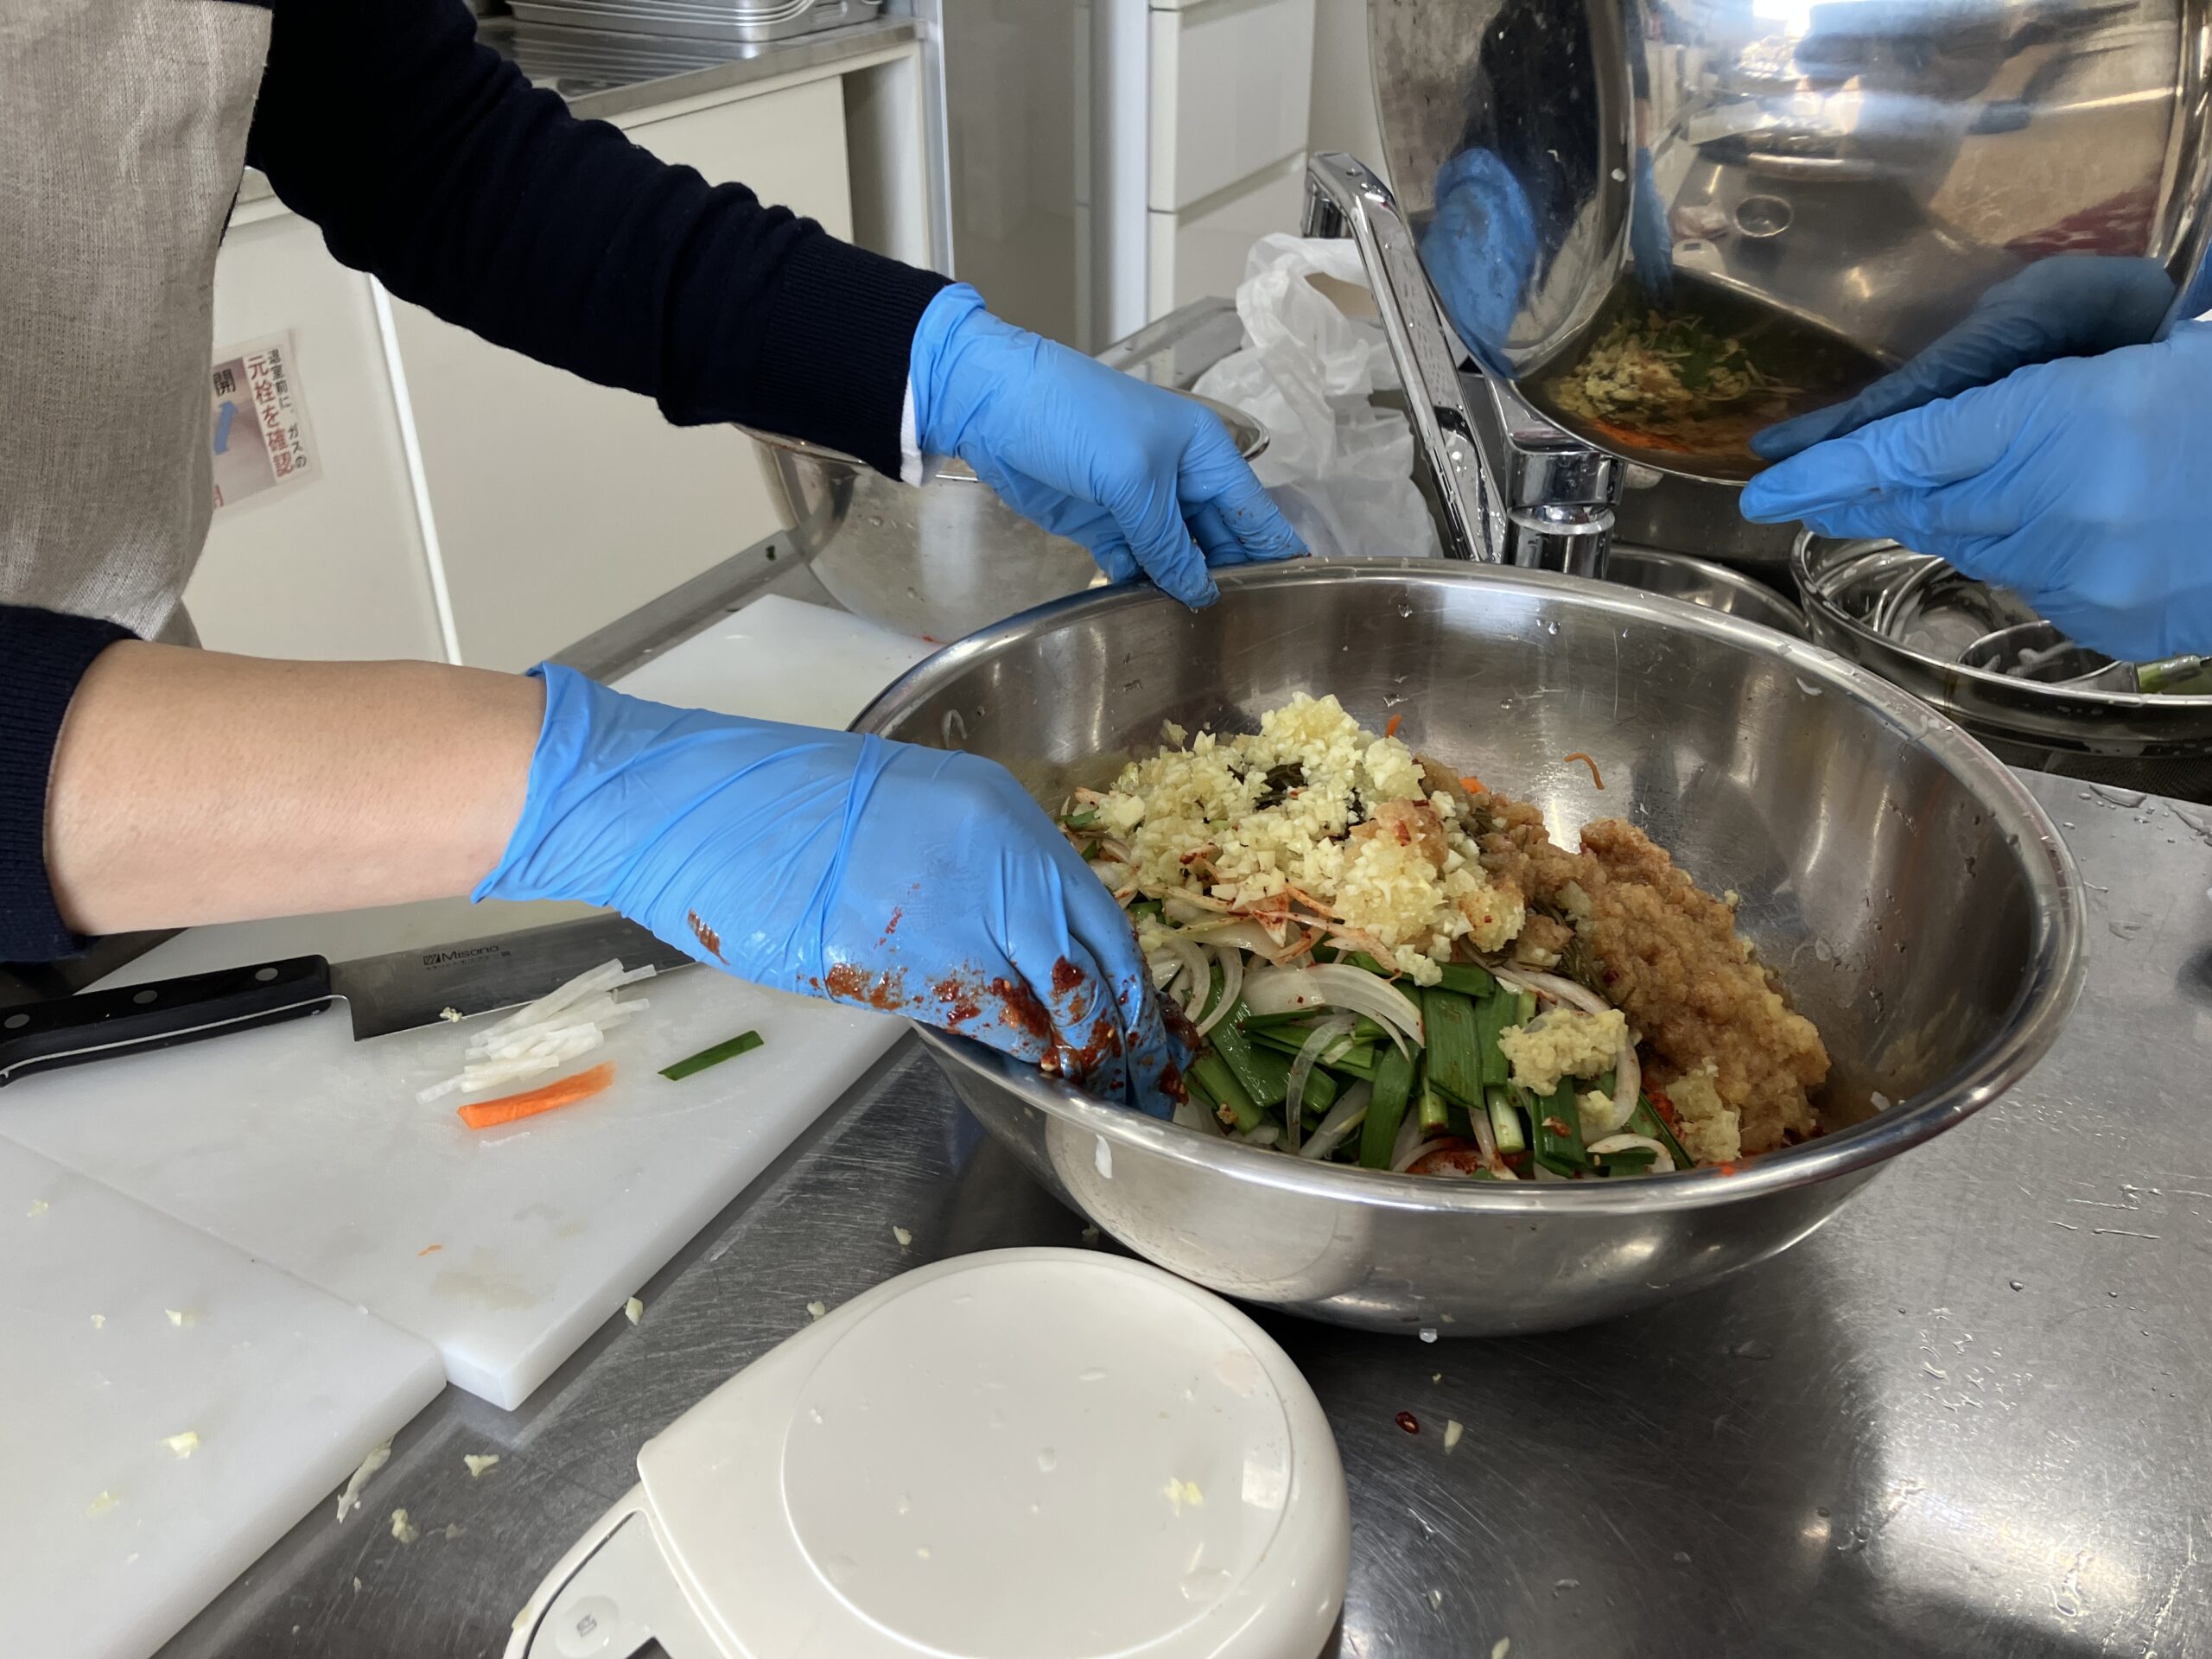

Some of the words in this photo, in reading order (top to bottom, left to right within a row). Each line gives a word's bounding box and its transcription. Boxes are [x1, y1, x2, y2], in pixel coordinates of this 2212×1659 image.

[213, 369, 236, 397] 開
[248, 355, 296, 477] 元栓を確認
[442, 945, 499, 962] Misono
